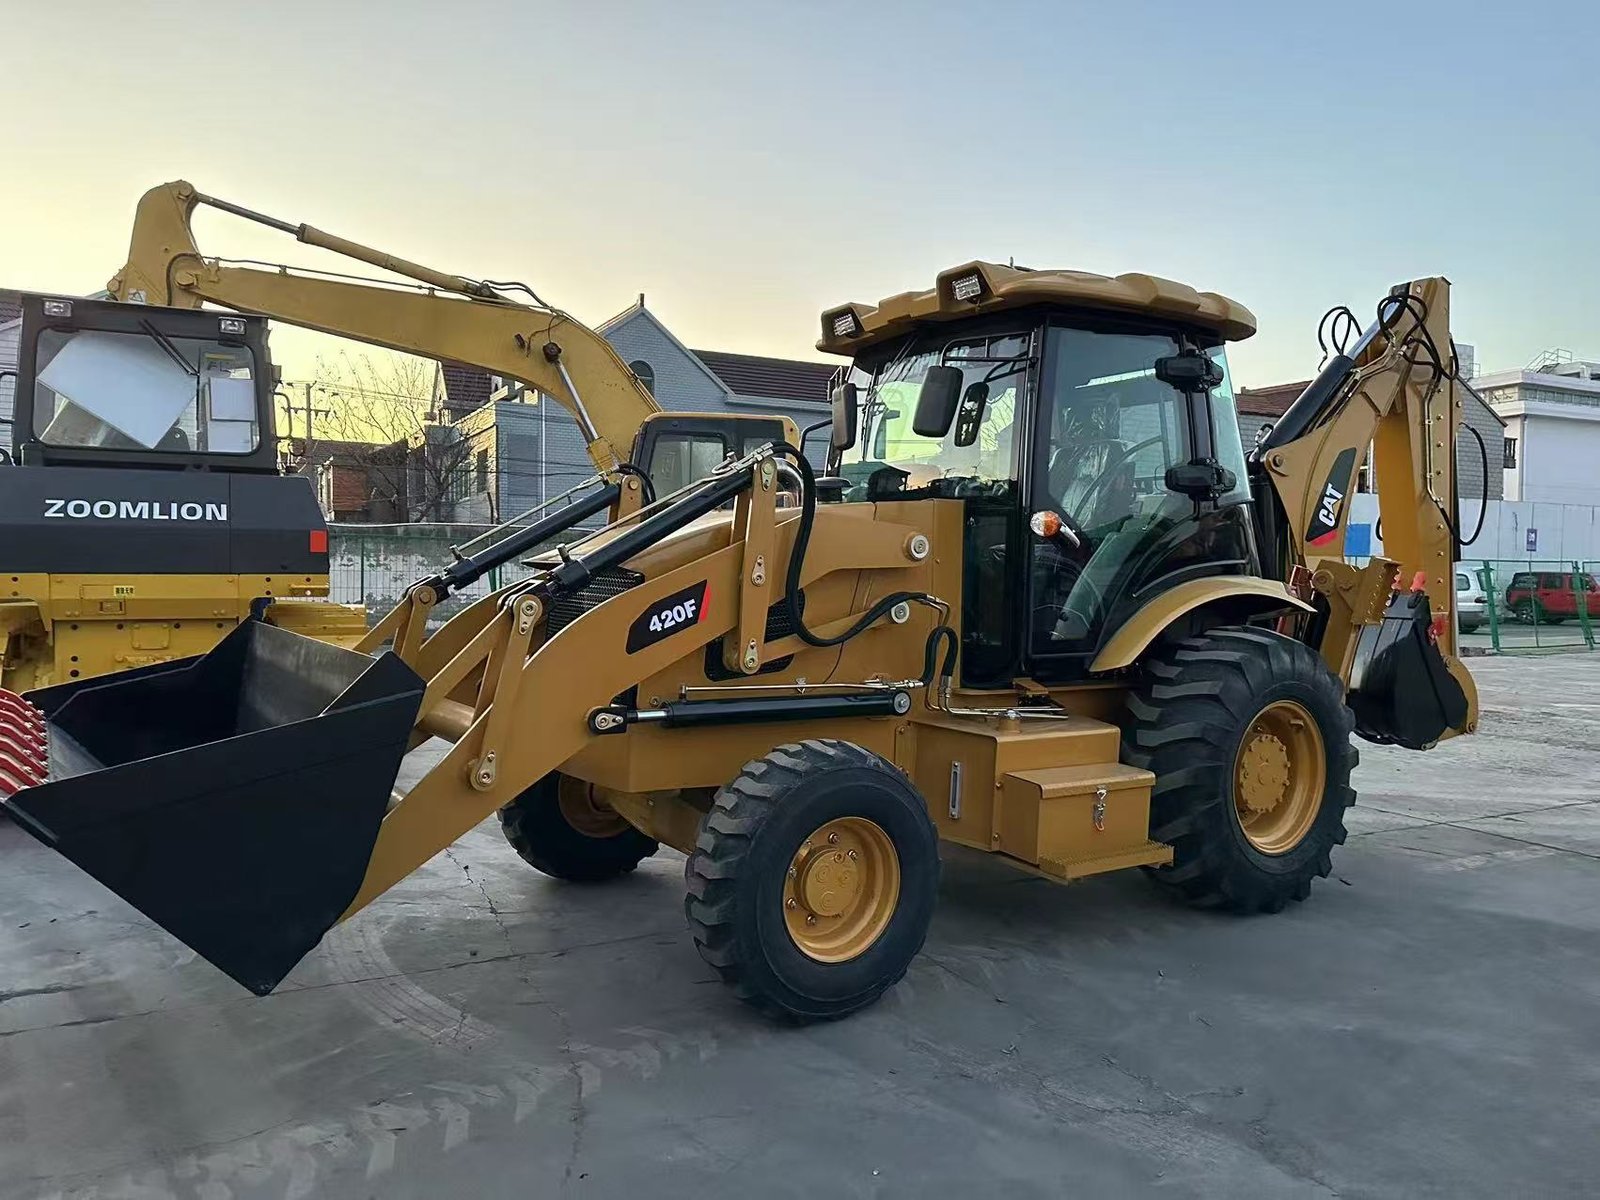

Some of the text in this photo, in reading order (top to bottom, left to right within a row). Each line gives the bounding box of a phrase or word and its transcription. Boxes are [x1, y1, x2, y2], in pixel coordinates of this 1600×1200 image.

[44, 499, 227, 521] ZOOMLION
[1319, 483, 1343, 527] CAT
[649, 599, 696, 632] 420F
